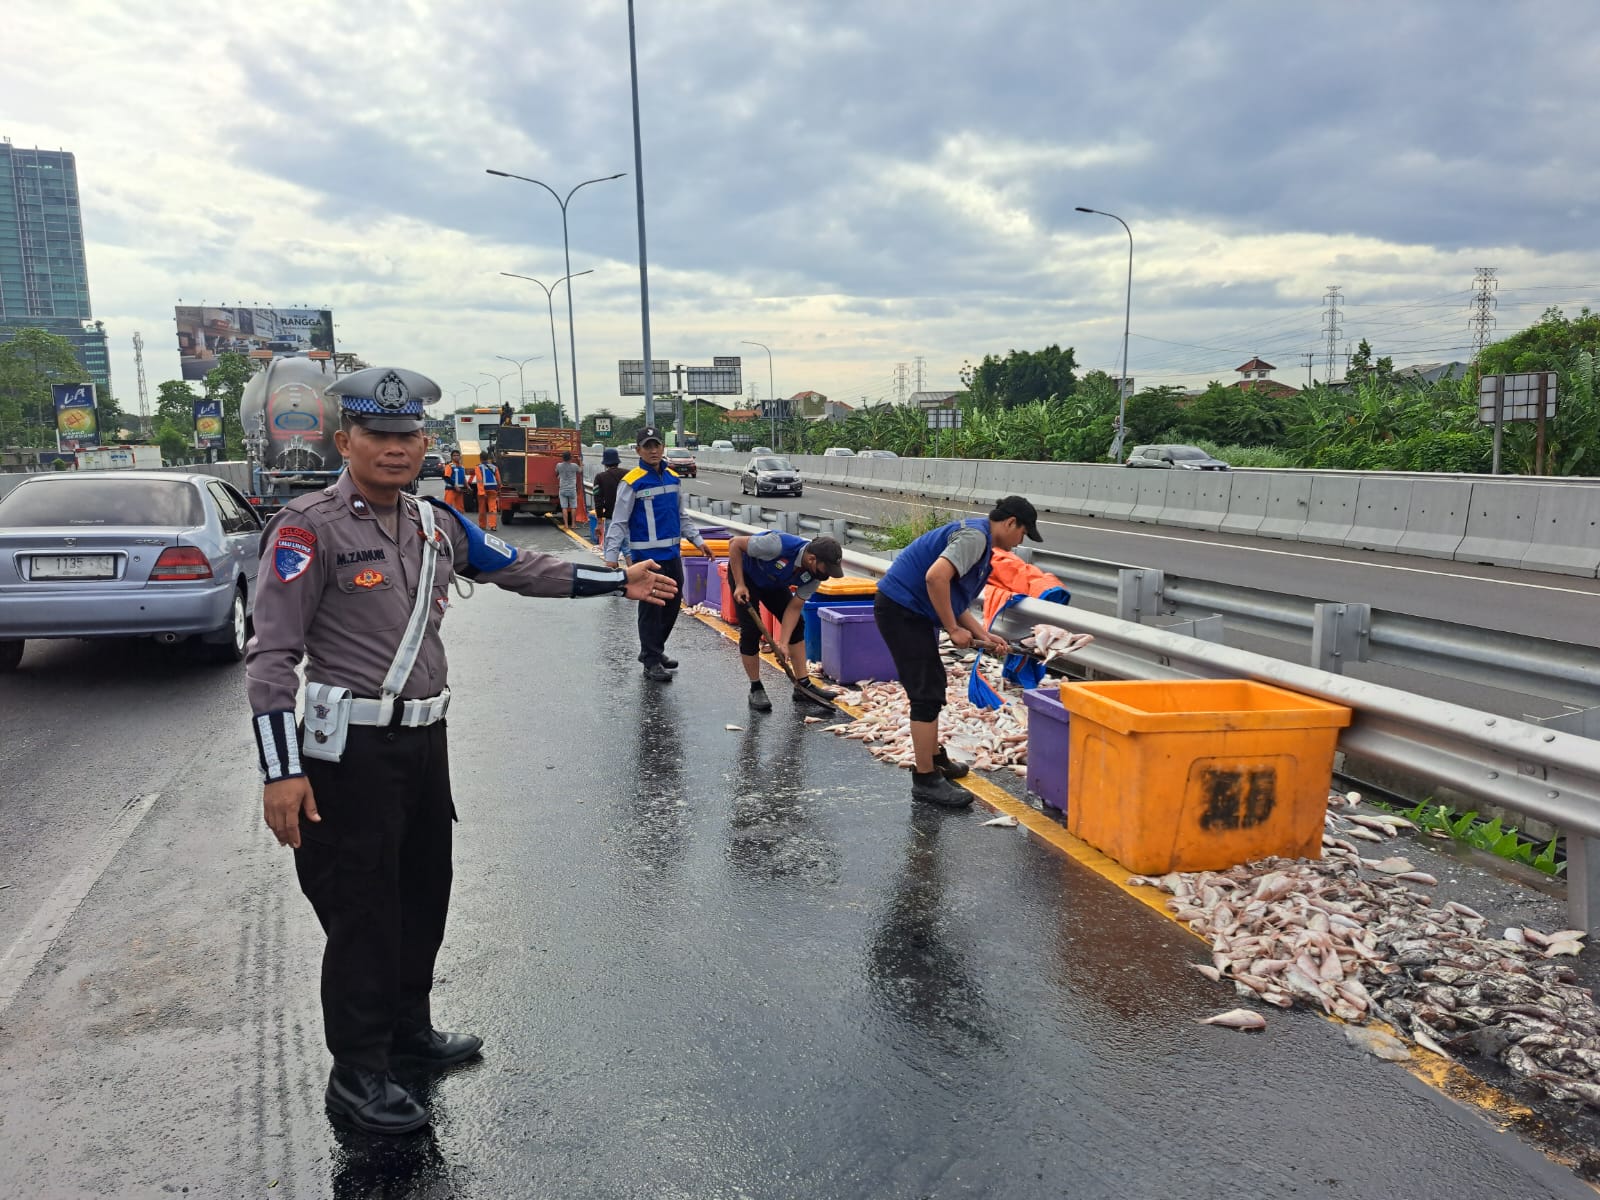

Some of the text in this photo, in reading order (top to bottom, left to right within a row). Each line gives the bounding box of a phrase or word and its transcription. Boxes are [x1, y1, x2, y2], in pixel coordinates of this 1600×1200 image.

[281, 318, 322, 326] RANGGA
[34, 558, 41, 570] L
[56, 557, 84, 570] 1135
